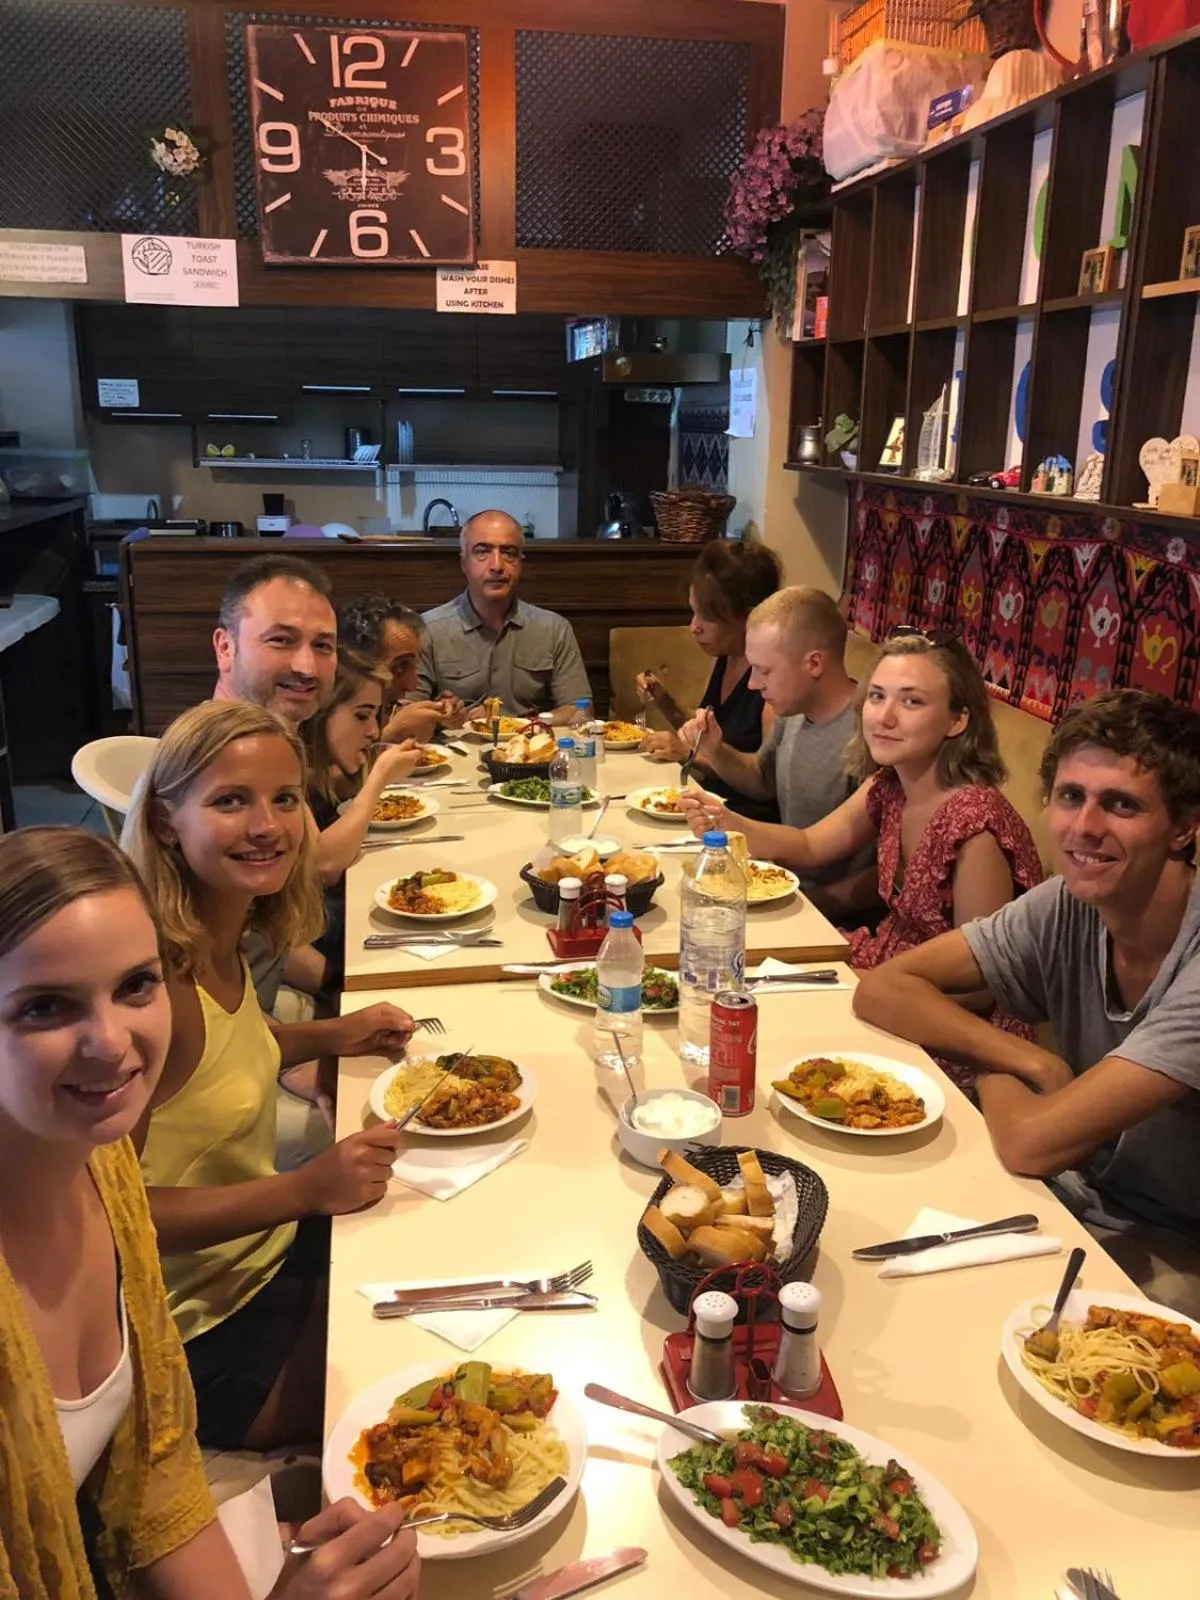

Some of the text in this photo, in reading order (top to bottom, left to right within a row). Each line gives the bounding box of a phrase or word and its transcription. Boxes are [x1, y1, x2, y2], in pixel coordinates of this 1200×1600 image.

[330, 35, 387, 89] 12
[329, 96, 397, 110] FABRIQUE
[308, 111, 420, 125] PRODUITS CHIMIQUES
[258, 122, 301, 173] 9
[426, 127, 466, 176] 3
[349, 209, 389, 257] 6
[186, 241, 221, 251] TURKISH
[191, 254, 218, 263] TOAST
[183, 267, 228, 278] SANDWICH
[441, 274, 464, 282] WASH
[466, 275, 488, 283] YOUR
[471, 300, 504, 309] KITCHEN
